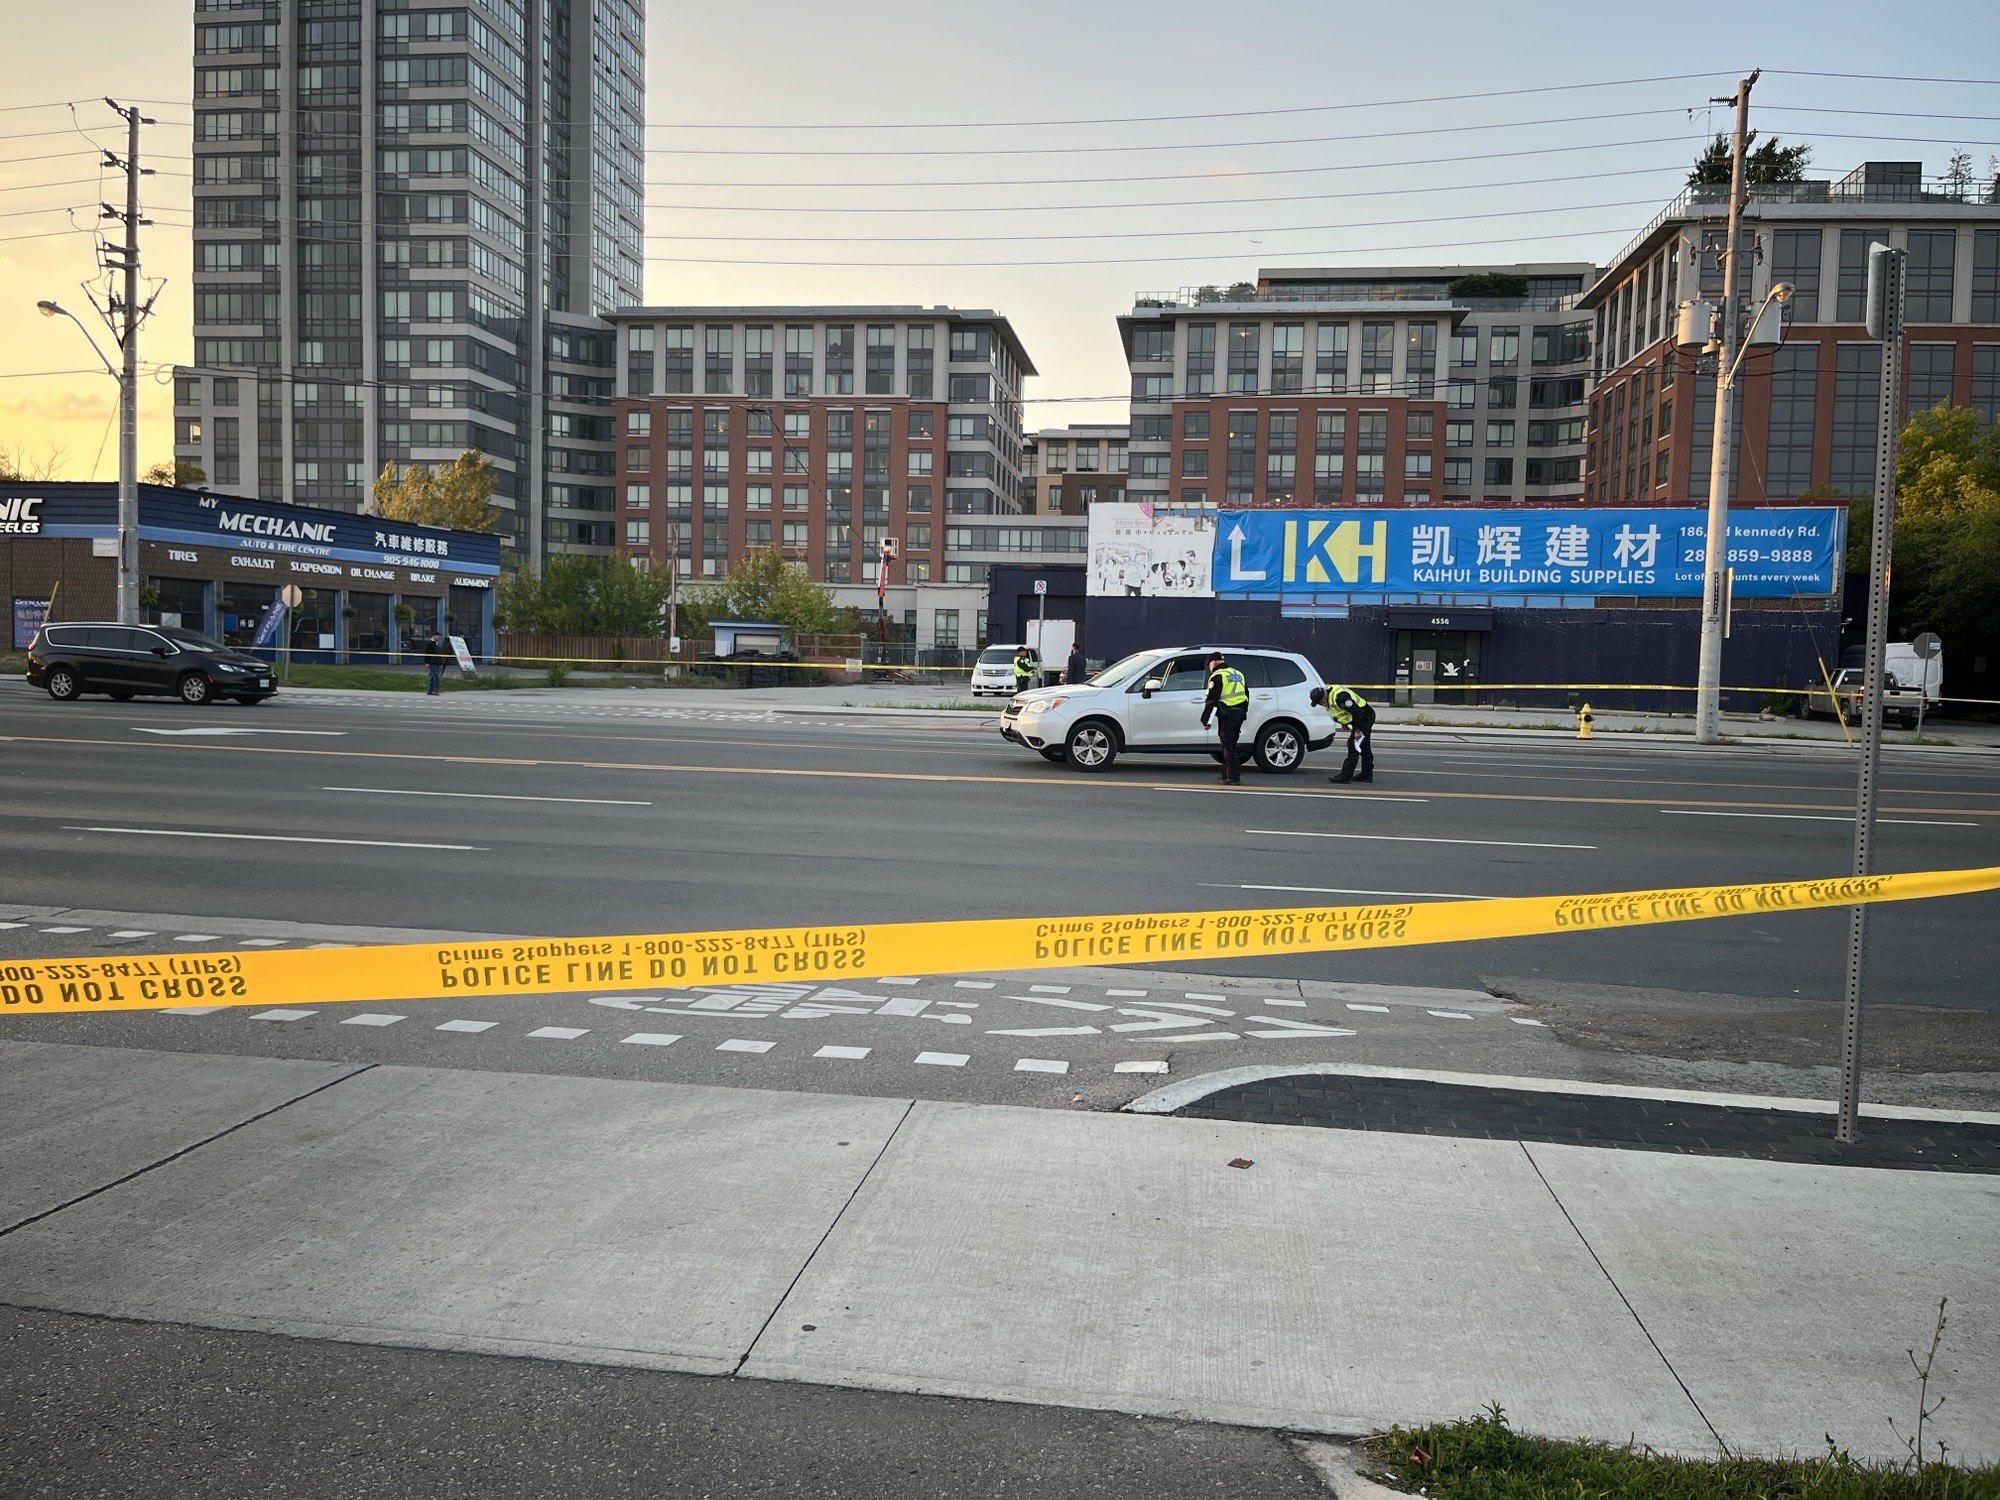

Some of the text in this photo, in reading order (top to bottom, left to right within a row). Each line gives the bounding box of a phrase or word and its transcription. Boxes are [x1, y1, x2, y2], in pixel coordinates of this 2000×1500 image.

[199, 497, 219, 509] MY
[219, 511, 337, 542] MECHANIC
[1735, 526, 1794, 539] kennedy
[1798, 526, 1820, 537] Rd.
[240, 539, 267, 549] AUTO
[277, 543, 296, 552] TIRE
[298, 546, 331, 556] CENTRE
[374, 531, 449, 556] 汽車維修服務
[1411, 523, 1662, 568] 凯辉建材
[168, 549, 198, 562] TIRES
[383, 555, 440, 569] 905-946-1000
[231, 556, 276, 569] EXHAUST
[290, 561, 342, 576] SUSPENSION
[350, 567, 396, 580] OIL CHANGE
[410, 573, 436, 583] BRAKE
[1413, 568, 1656, 584] KAIHUI BUILDING SUPPLIES
[1675, 573, 1693, 581] Lot
[1760, 574, 1790, 583] every
[1792, 573, 1820, 582] week
[453, 577, 490, 588] ALIGNMENT
[1431, 617, 1450, 625] 4556
